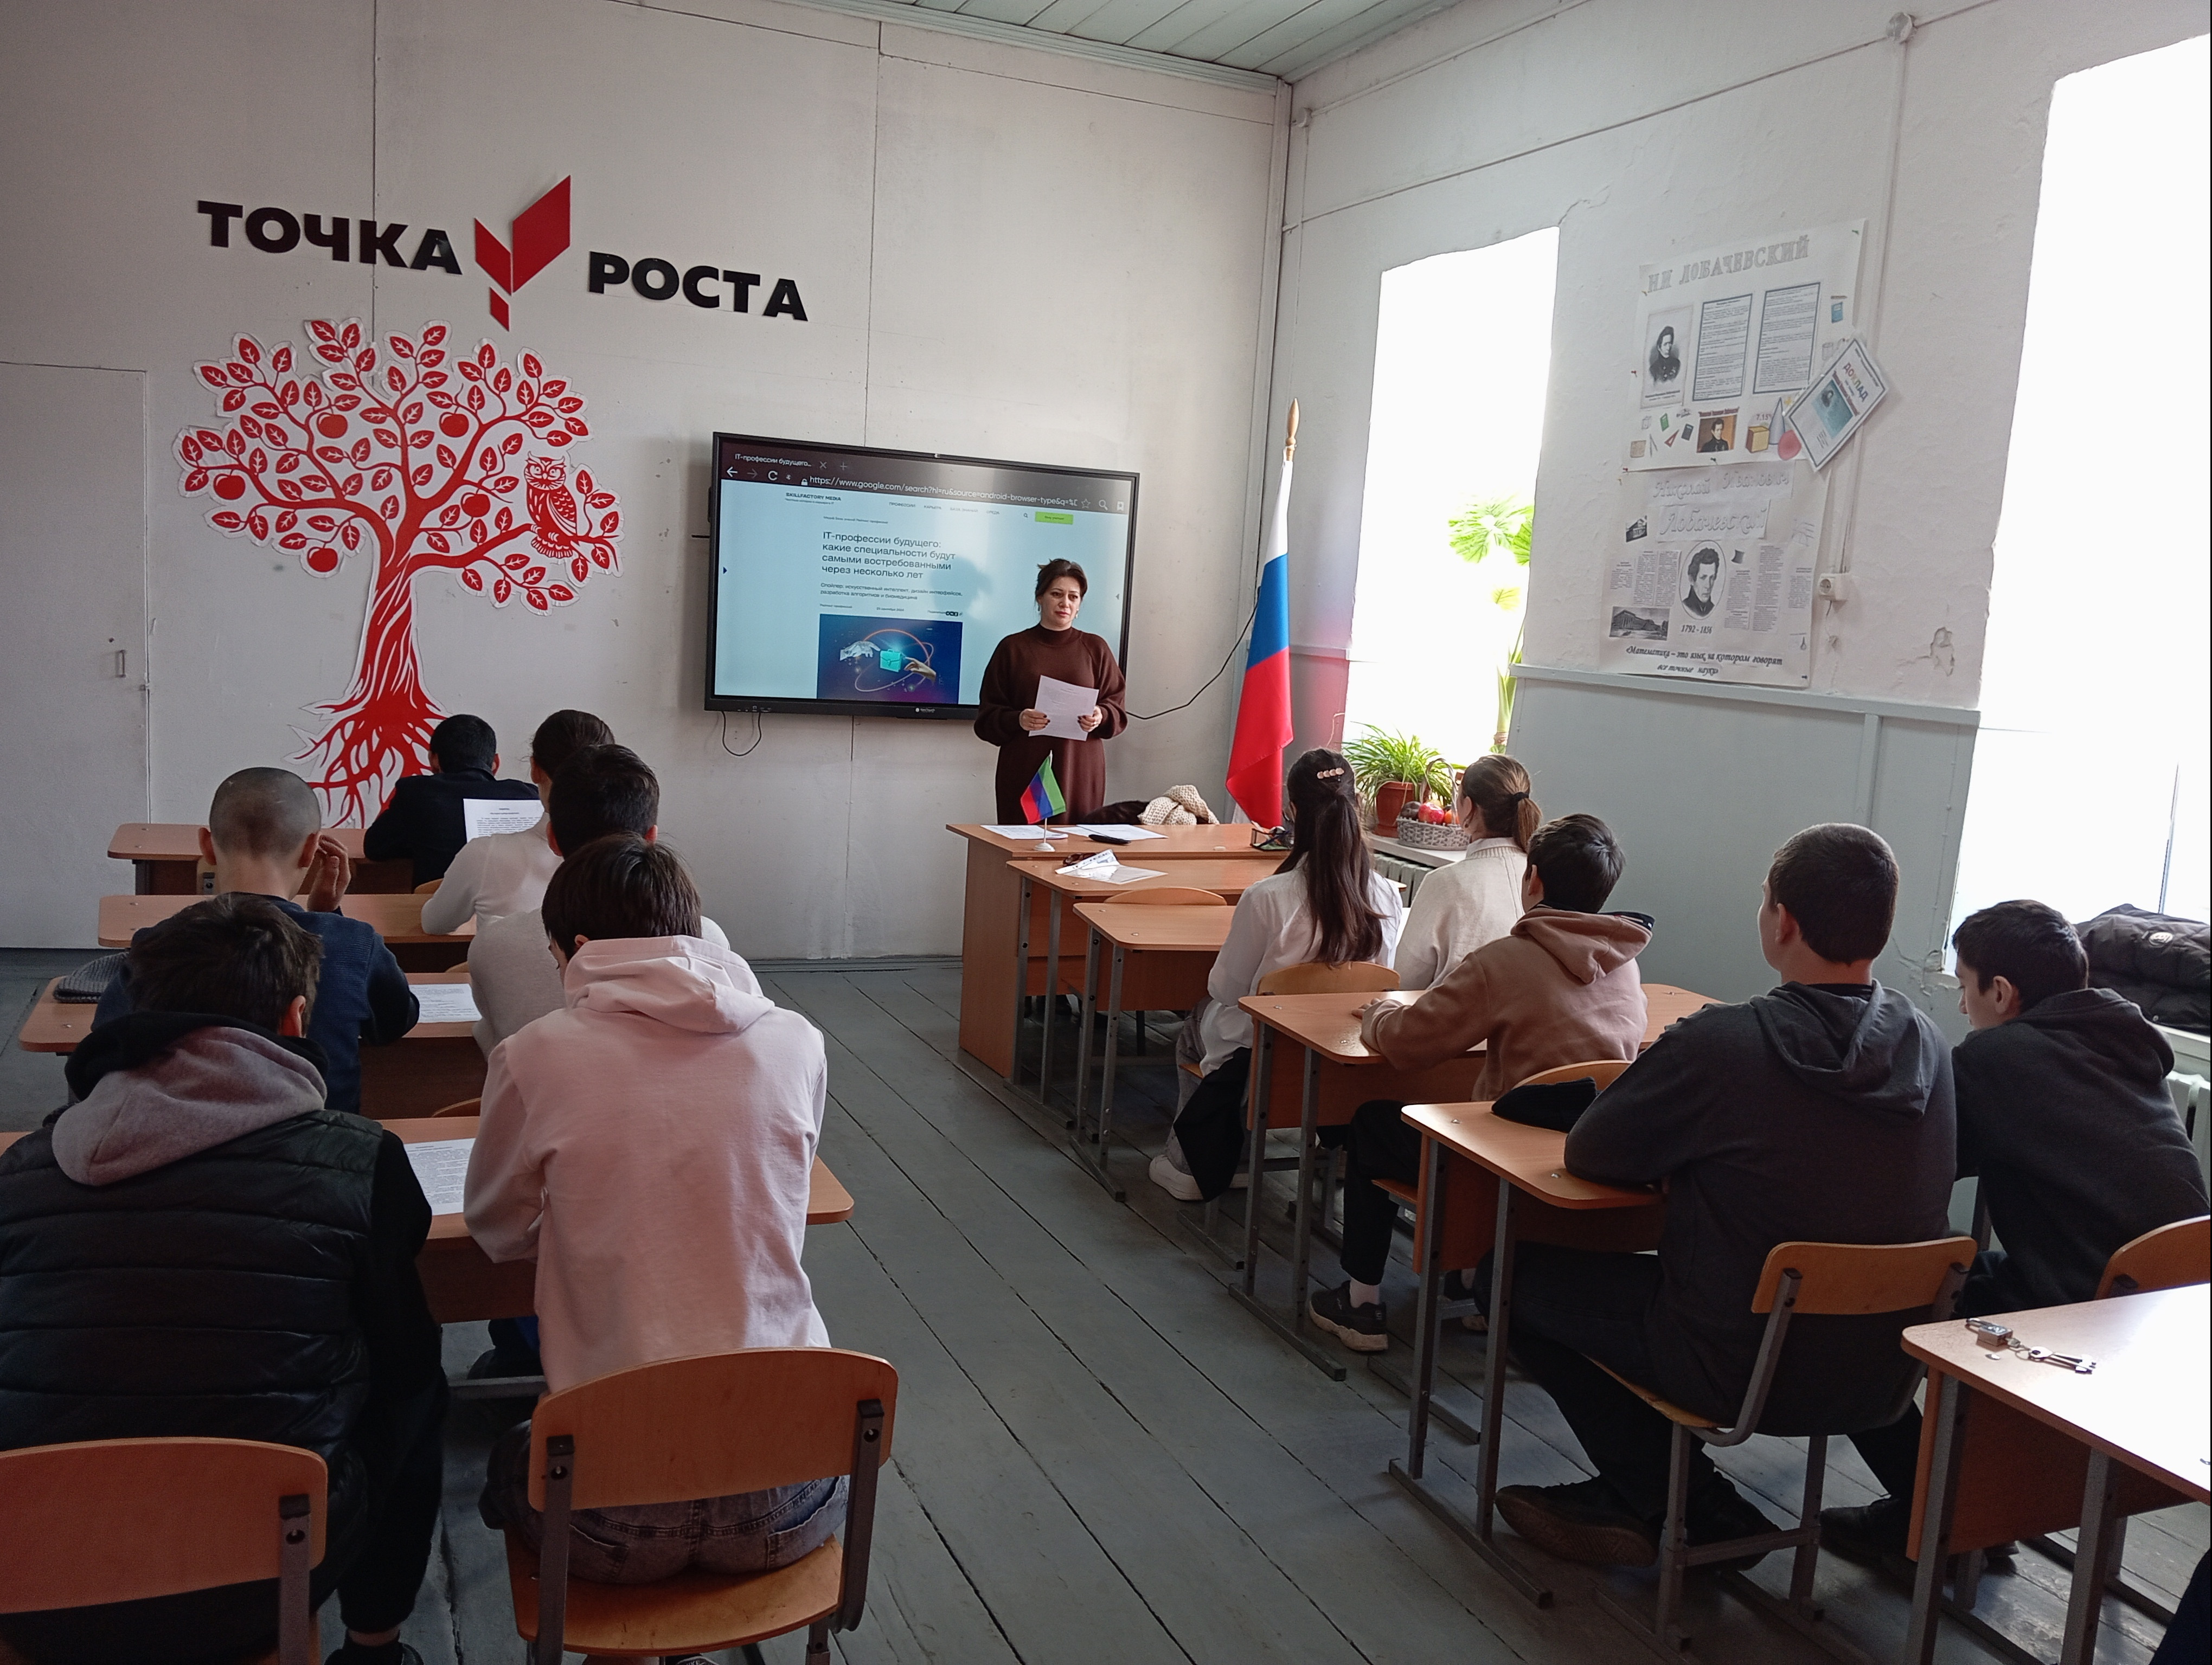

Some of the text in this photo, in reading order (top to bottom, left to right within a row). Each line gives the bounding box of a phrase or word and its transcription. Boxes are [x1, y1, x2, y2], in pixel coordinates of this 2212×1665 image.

[198, 200, 808, 322] ТОЧКА РОСТА
[1679, 235, 1810, 285] ЛОБАЧЕВСКИЙ
[1843, 362, 1868, 402] ДОКЛАД
[735, 453, 778, 464] IT-профессии
[786, 492, 824, 500] SKILLFACTORY
[823, 531, 941, 548] IT-профессии будущего:
[823, 543, 956, 561] какие специальности будут
[822, 555, 951, 570] самыми востребованными
[822, 565, 851, 575] через
[854, 567, 904, 577] несколько
[1716, 653, 1750, 663] котором
[1752, 656, 1783, 667] говорят
